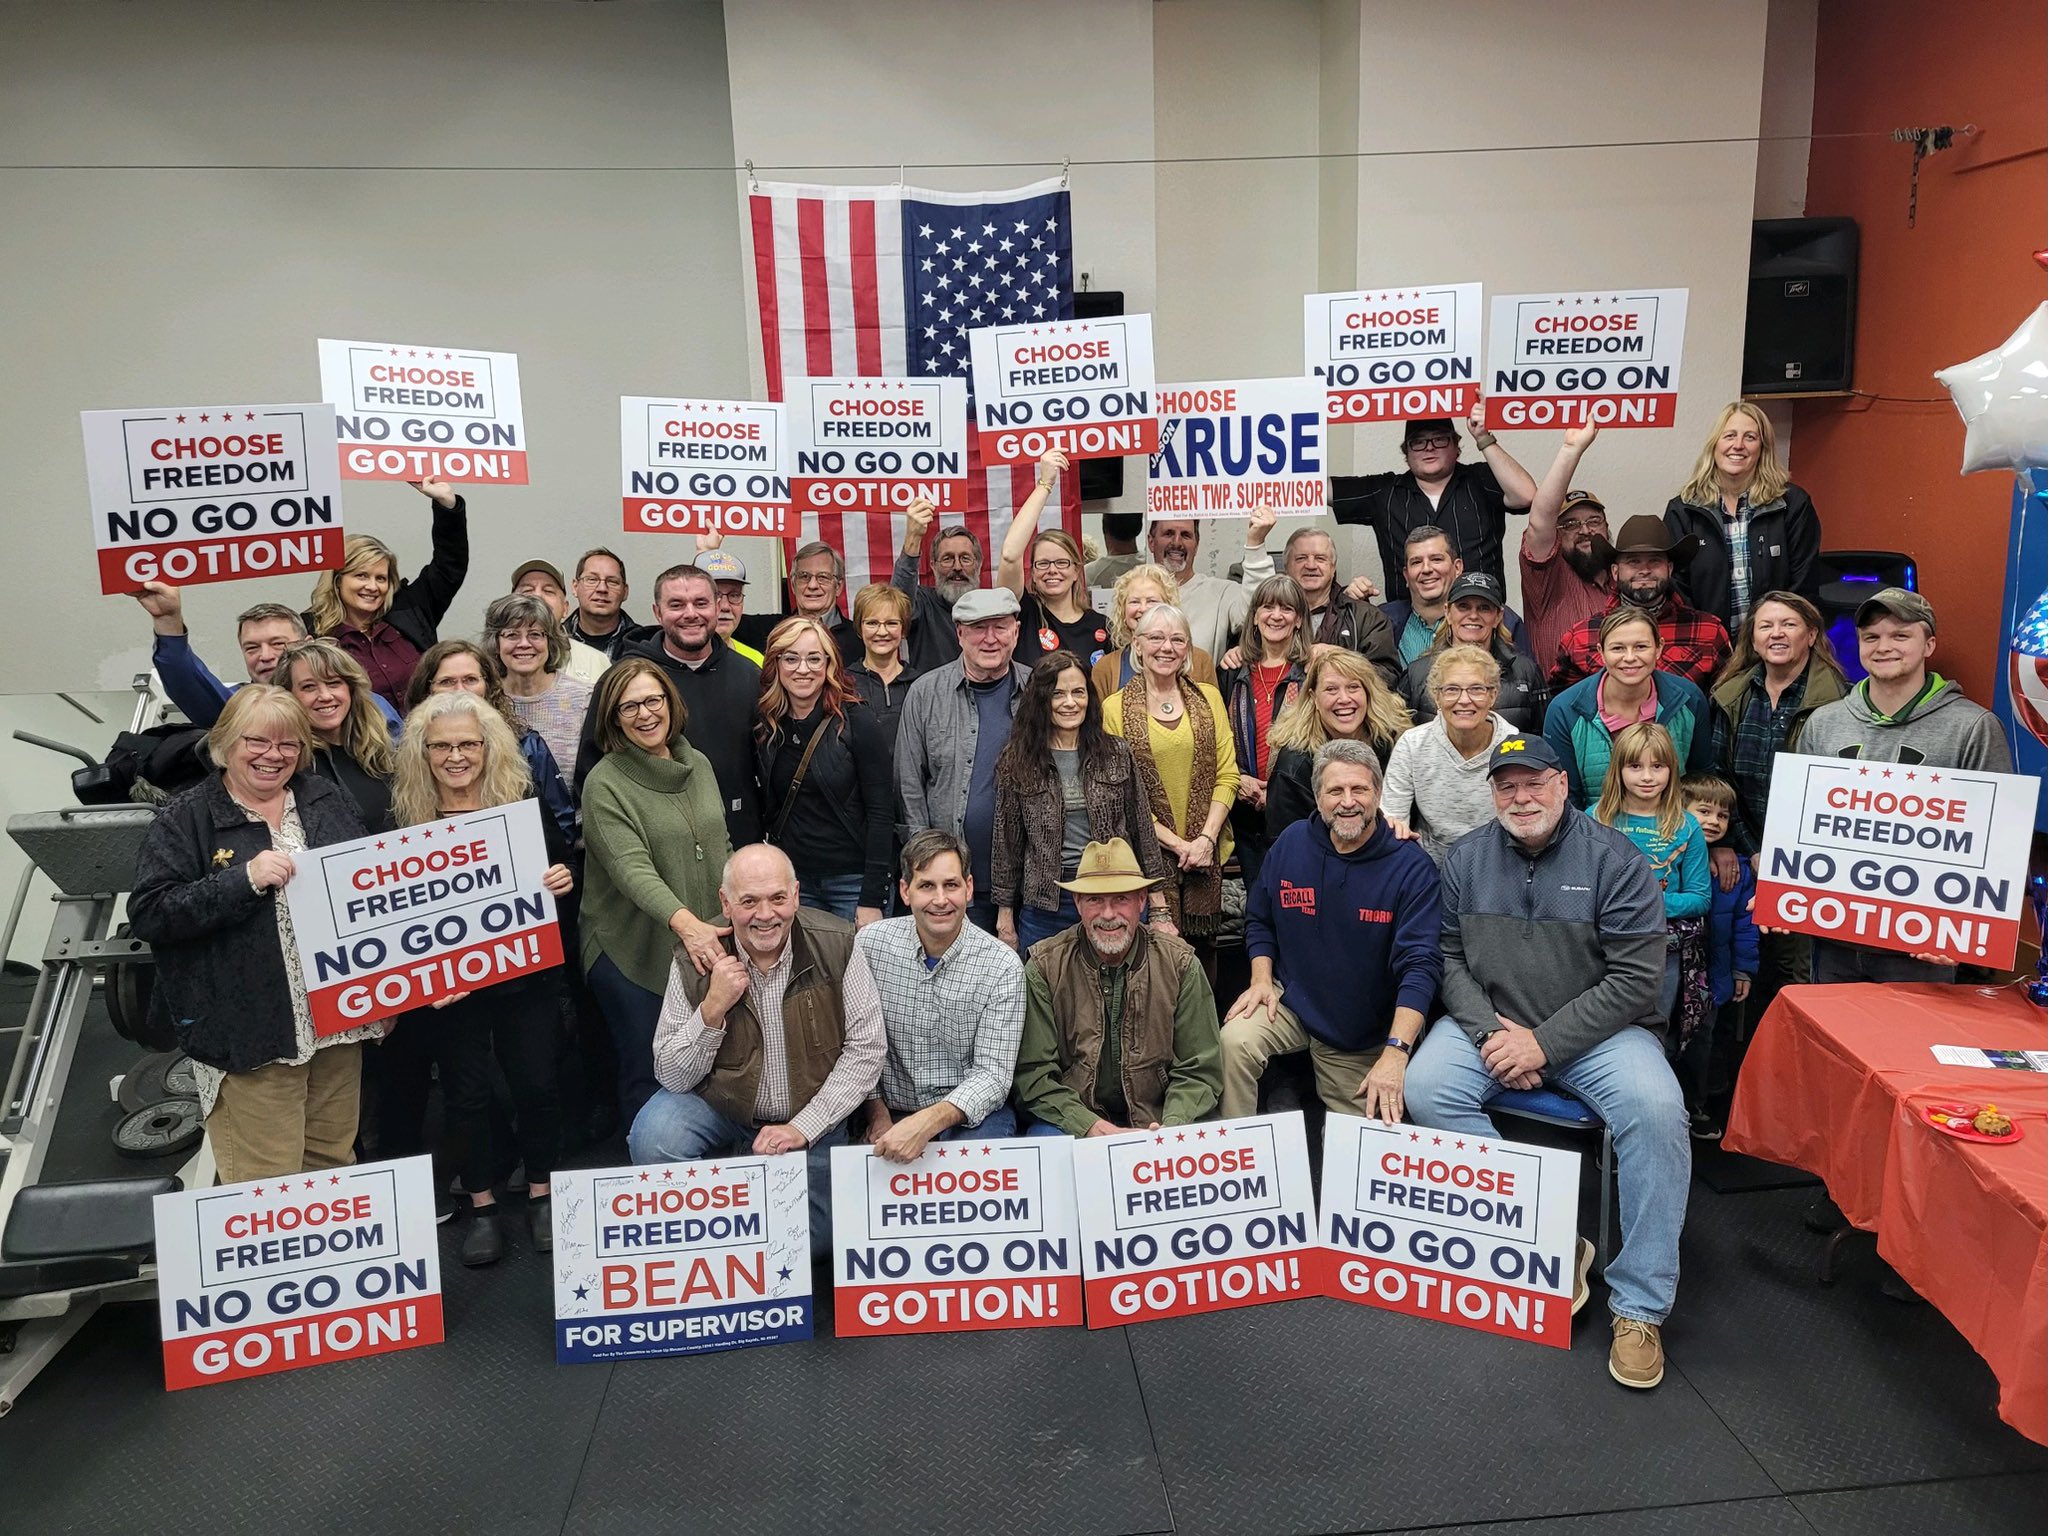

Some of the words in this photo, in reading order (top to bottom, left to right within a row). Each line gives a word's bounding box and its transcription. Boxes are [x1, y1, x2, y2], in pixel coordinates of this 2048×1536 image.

[1346, 308, 1439, 329] CHOOSE
[1535, 314, 1638, 333] CHOOSE
[1015, 341, 1109, 364] CHOOSE
[1340, 329, 1445, 354] FREEDOM
[1526, 336, 1643, 355] FREEDOM
[370, 365, 474, 387] CHOOSE
[1010, 363, 1118, 390] FREEDOM
[1314, 364, 1359, 386] NO
[1369, 361, 1415, 384] GO
[1425, 357, 1471, 380] ON
[1496, 369, 1545, 392] NO
[1556, 368, 1606, 391] GO
[1618, 366, 1669, 389] ON
[364, 386, 484, 409] FREEDOM
[829, 400, 923, 416] CHOOSE
[986, 401, 1033, 426] NO
[1043, 397, 1090, 421] GO
[1100, 391, 1147, 417] ON
[1156, 390, 1236, 414] HOOSE
[1328, 388, 1464, 419] GOTION!
[1502, 399, 1657, 424] GOTION!
[336, 416, 390, 440] NO
[402, 419, 454, 443] GO
[465, 423, 515, 446] ON
[665, 421, 759, 440] CHOOSE
[824, 422, 930, 437] FREEDOM
[997, 424, 1141, 458] GOTION!
[1150, 412, 1320, 478] KRUSE
[1151, 422, 1176, 469] JASON
[151, 434, 283, 460] CHOOSE
[349, 449, 510, 478] GOTION!
[659, 442, 766, 461] FREEDOM
[799, 451, 845, 473] NO
[855, 452, 901, 474] GO
[912, 452, 958, 474] ON
[144, 461, 294, 490] FREEDOM
[632, 471, 679, 494] NO
[689, 473, 736, 497] GO
[746, 475, 790, 499] ON
[807, 481, 951, 508] GOTION!
[1154, 485, 1197, 511] GREEN
[1202, 484, 1232, 509] TWP.
[1237, 481, 1323, 508] SUPERVISOR
[108, 508, 177, 542] NO
[192, 502, 257, 534] GO
[271, 496, 331, 527] ON
[641, 503, 784, 531] GOTION!
[124, 534, 324, 582] GOTION!
[1828, 788, 1966, 823] CHOOSE
[1814, 814, 1973, 854] FREEDOM
[352, 839, 488, 890] CHOOSE
[1771, 848, 1836, 883] NO
[1850, 860, 1919, 896] GO
[1934, 872, 2009, 912] ON
[346, 864, 501, 923] FREEDOM
[315, 938, 386, 982] NO
[401, 916, 467, 955] GO
[481, 892, 545, 932] ON
[1777, 892, 1990, 956] GOTION!
[338, 934, 540, 1018] GOTION!
[890, 1169, 1018, 1196] CHOOSE
[1133, 1148, 1255, 1184] CHOOSE
[1381, 1153, 1514, 1196] CHOOSE
[612, 1183, 749, 1217] CHOOSE
[882, 1198, 1028, 1226] FREEDOM
[1127, 1176, 1267, 1215] FREEDOM
[1370, 1179, 1523, 1228] FREEDOM
[225, 1195, 371, 1238] CHOOSE
[604, 1213, 760, 1249] FREEDOM
[216, 1223, 383, 1272] FREEDOM
[846, 1246, 910, 1280] NO
[925, 1242, 989, 1276] GO
[1003, 1238, 1067, 1272] ON
[1095, 1234, 1158, 1272] NO
[1171, 1224, 1232, 1260] GO
[1245, 1212, 1306, 1249] ON
[1331, 1213, 1395, 1253] NO
[1409, 1230, 1475, 1269] GO
[1490, 1246, 1560, 1289] ON
[176, 1290, 251, 1331] NO
[267, 1275, 340, 1314] GO
[356, 1259, 427, 1299] ON
[603, 1252, 765, 1309] BEAN
[1111, 1258, 1300, 1315] GOTION!
[1340, 1261, 1545, 1333] GOTION!
[859, 1284, 1058, 1326] GOTION!
[193, 1306, 417, 1374] GOTION!
[566, 1325, 621, 1347] FOR
[630, 1306, 803, 1346] SUPERVISOR
